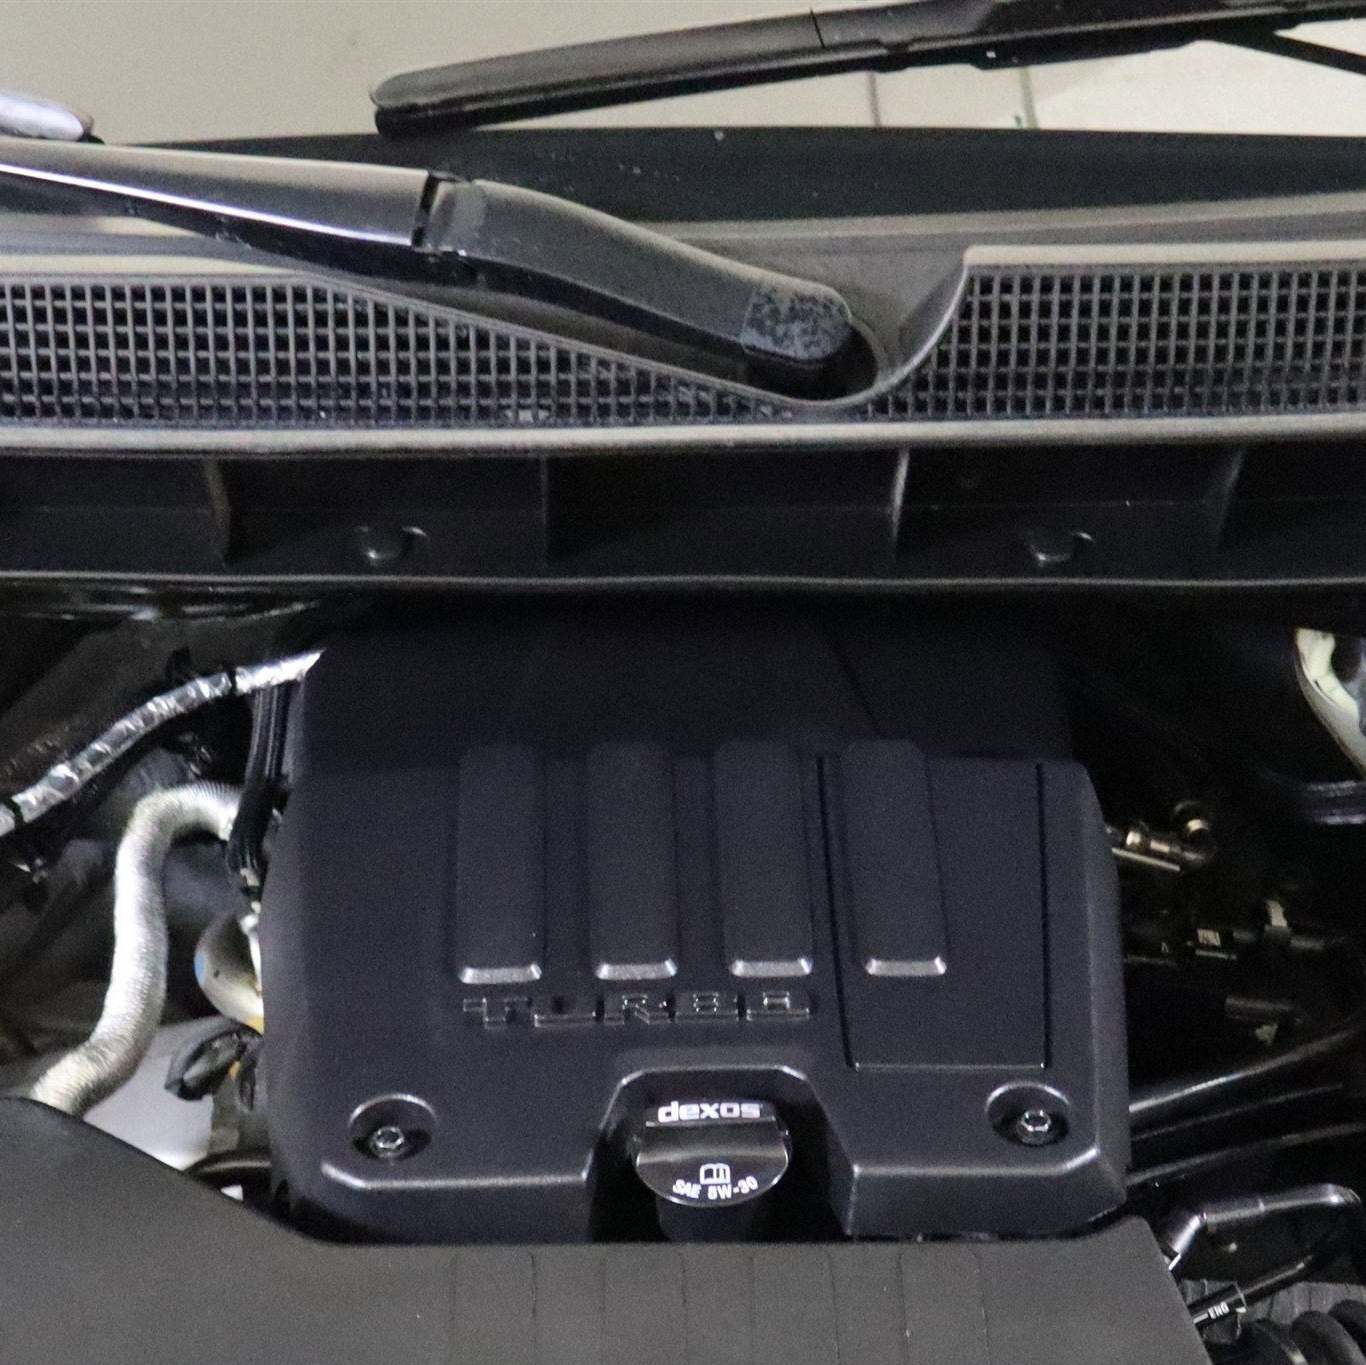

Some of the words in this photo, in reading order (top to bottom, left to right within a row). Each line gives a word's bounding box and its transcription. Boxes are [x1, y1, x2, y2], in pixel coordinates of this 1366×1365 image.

[462, 992, 812, 1029] TURBO
[658, 1101, 761, 1123] dexos
[672, 1179, 702, 1199] SAE
[707, 1175, 758, 1200] 5W-30
